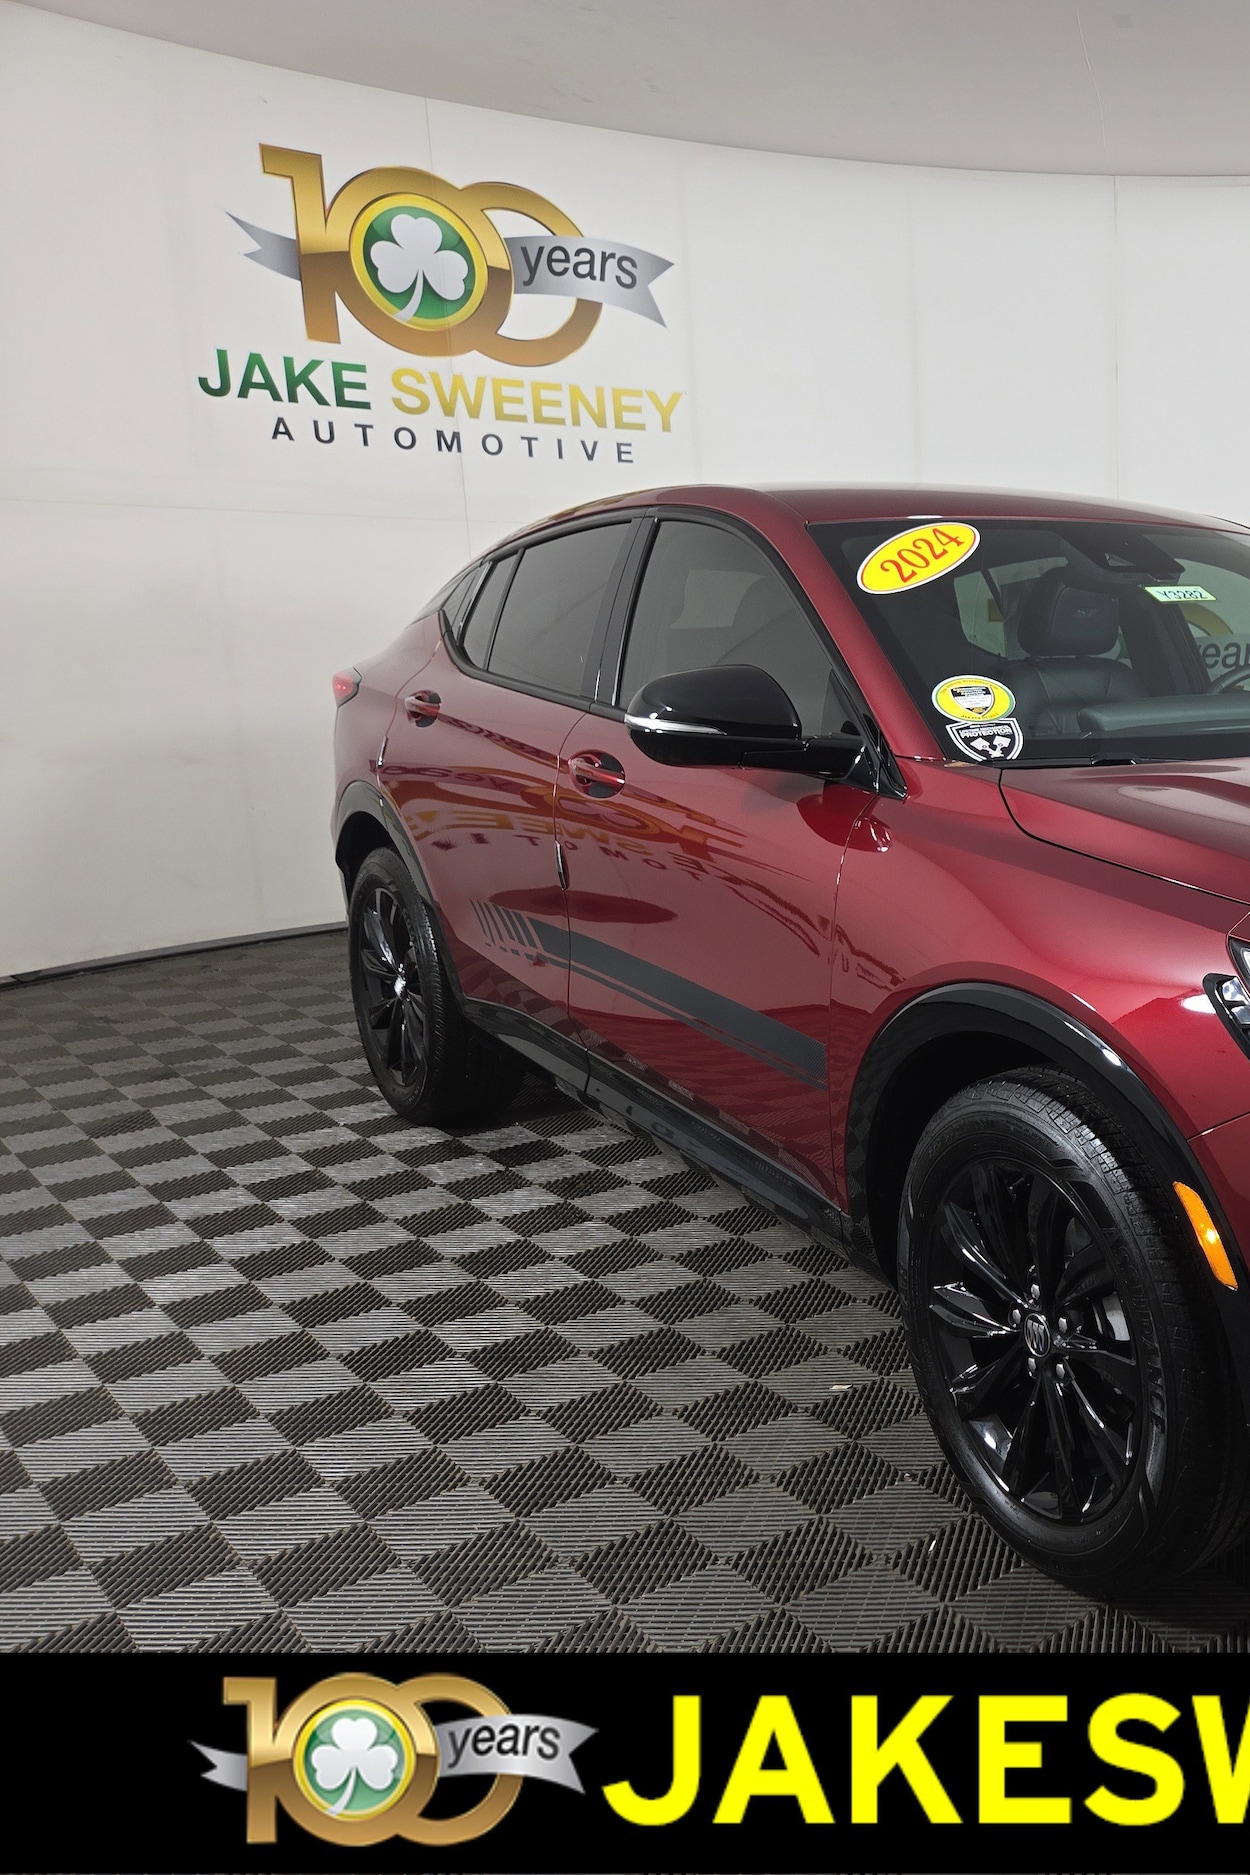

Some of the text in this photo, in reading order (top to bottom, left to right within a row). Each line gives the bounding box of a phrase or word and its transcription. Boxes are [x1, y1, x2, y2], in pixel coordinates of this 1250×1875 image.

[259, 144, 638, 366] 100 years
[198, 348, 683, 433] JAKE SWEENEY
[271, 417, 634, 463] AUTOMOTIVE
[880, 527, 964, 584] 2024
[1157, 590, 1208, 600] Y3282
[959, 726, 1013, 738] PROTECTION
